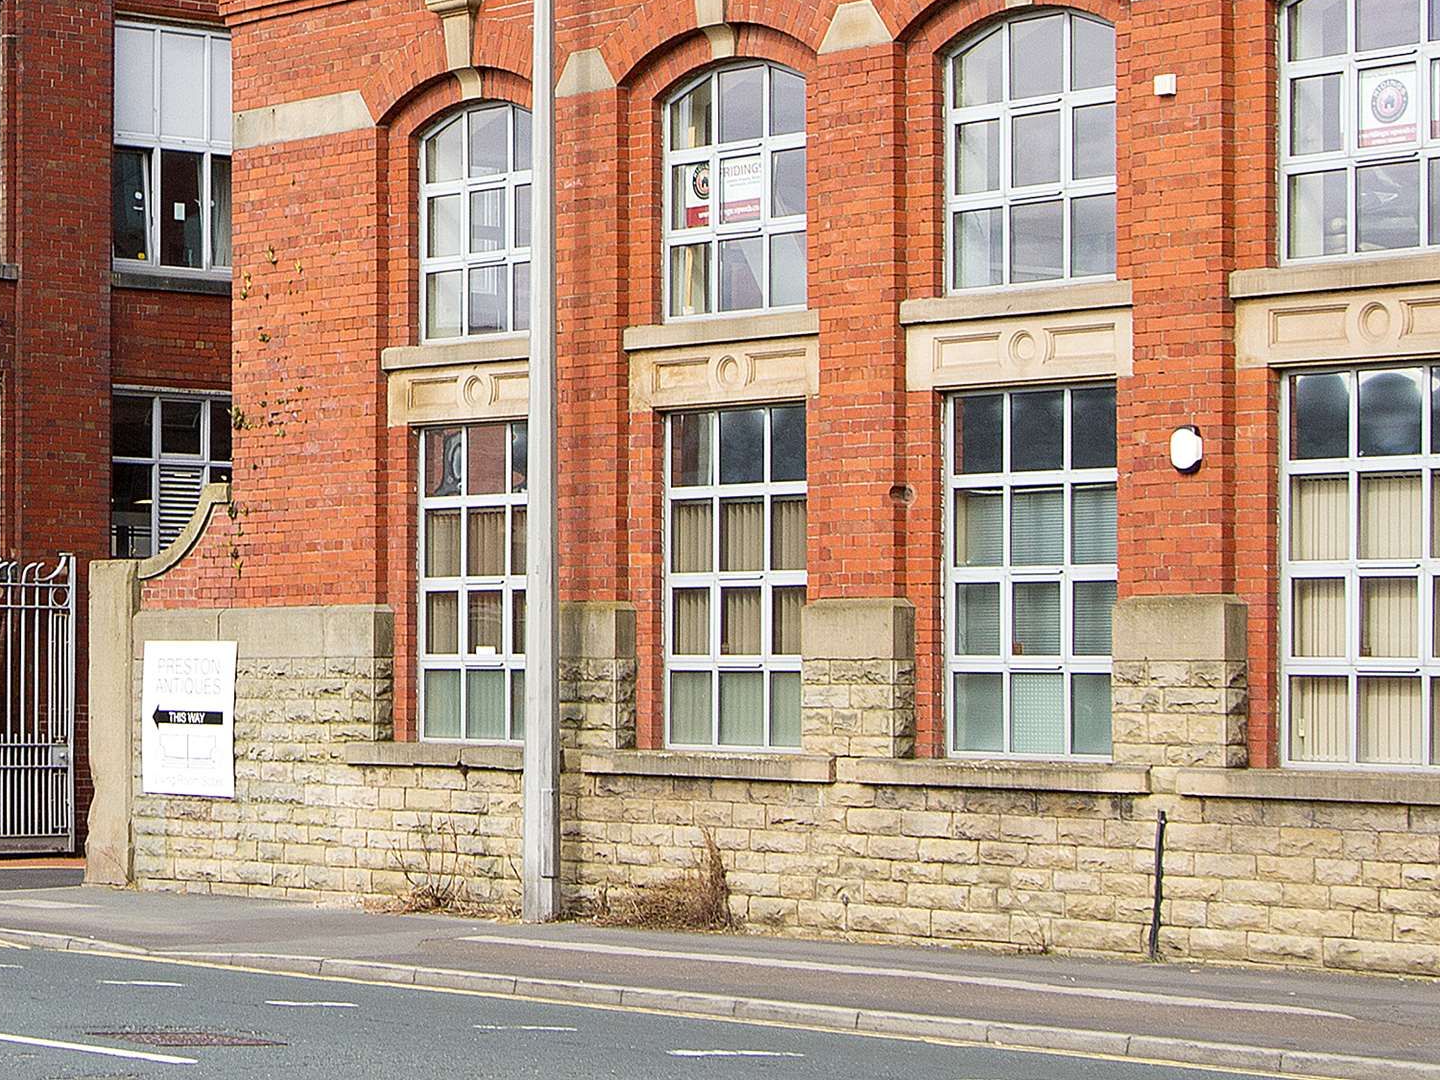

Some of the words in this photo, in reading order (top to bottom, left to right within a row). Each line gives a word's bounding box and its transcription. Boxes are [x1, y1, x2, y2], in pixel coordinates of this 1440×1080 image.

[724, 163, 762, 177] RIDING
[157, 657, 221, 675] PRESTON
[155, 677, 222, 695] ANTIQUES
[168, 711, 187, 724] THIS
[187, 712, 206, 724] WAY
